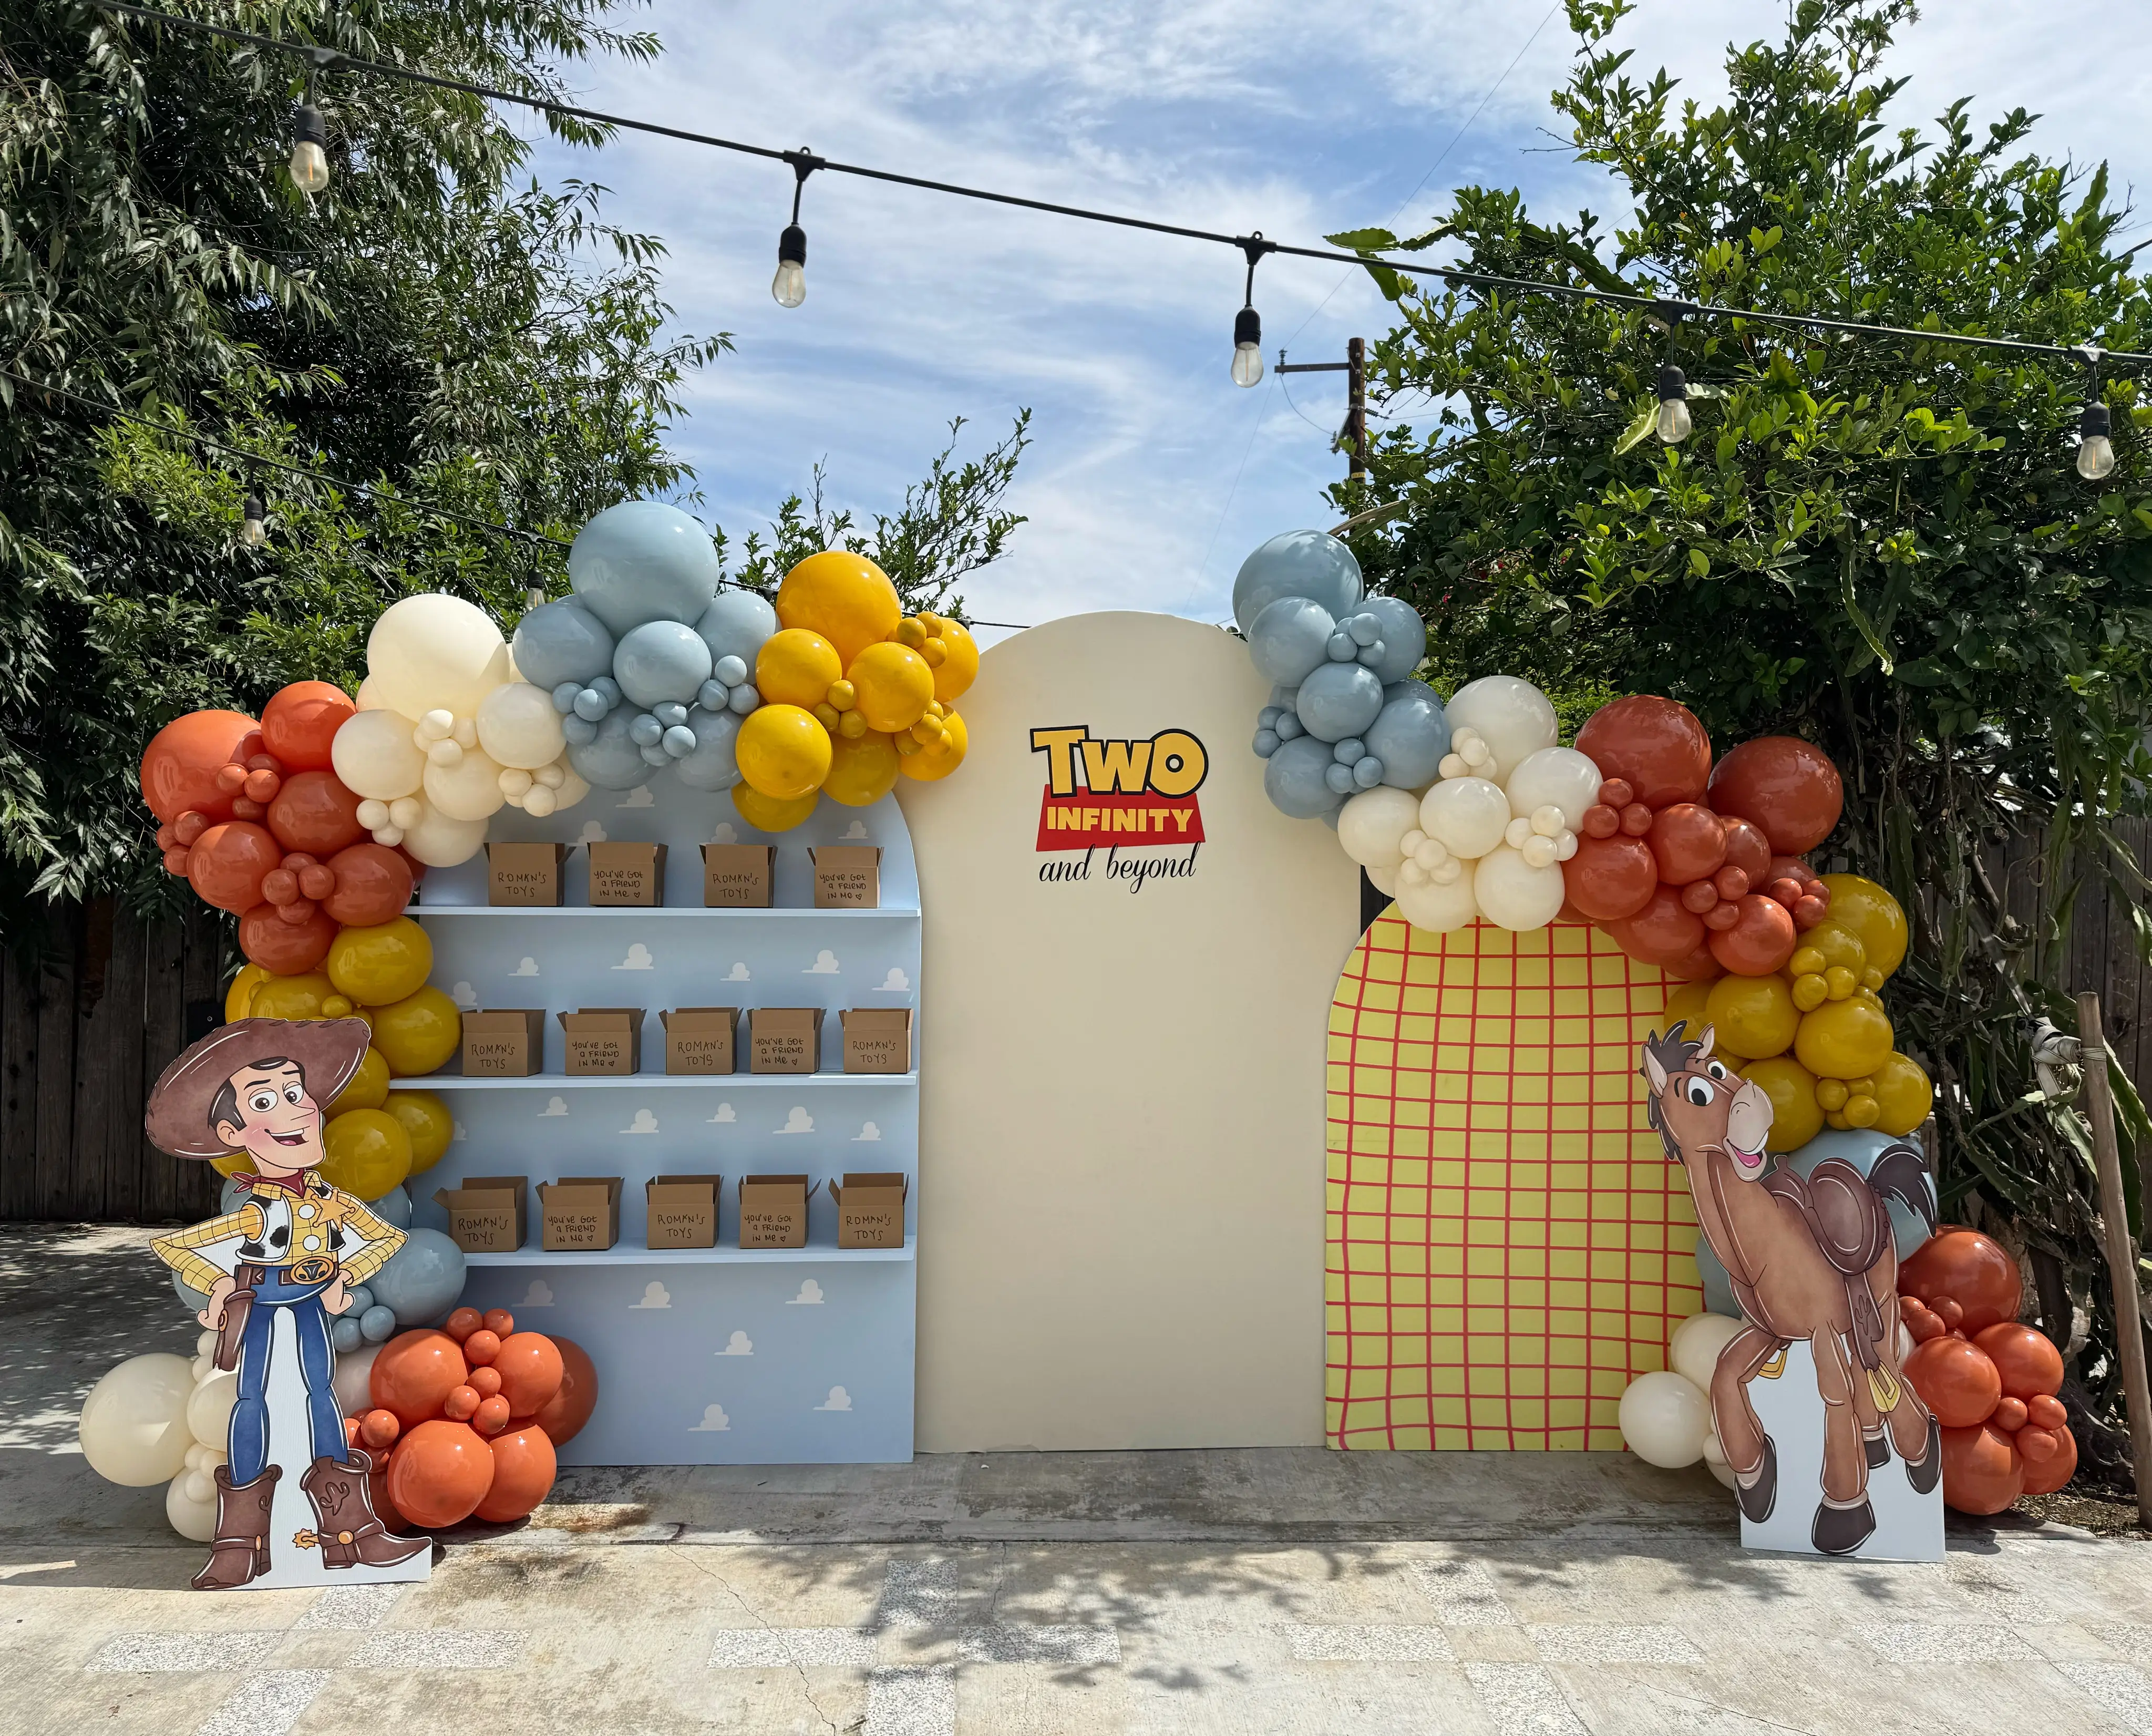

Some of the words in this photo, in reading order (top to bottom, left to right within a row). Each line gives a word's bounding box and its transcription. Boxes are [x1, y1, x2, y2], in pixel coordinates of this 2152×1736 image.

[1030, 725, 1209, 799] TWO
[1047, 806, 1194, 832] INFINITY
[1039, 843, 1096, 882] and
[1106, 840, 1201, 894] beyond
[505, 885, 535, 897] TOYS
[719, 887, 749, 899] TOYS
[479, 1057, 506, 1070] TOYS
[685, 1053, 713, 1066] TOYS
[860, 1053, 887, 1064] TOYS
[464, 1231, 495, 1245] TOYS
[666, 1227, 692, 1239] TOYS
[853, 1229, 883, 1241] TOYS
